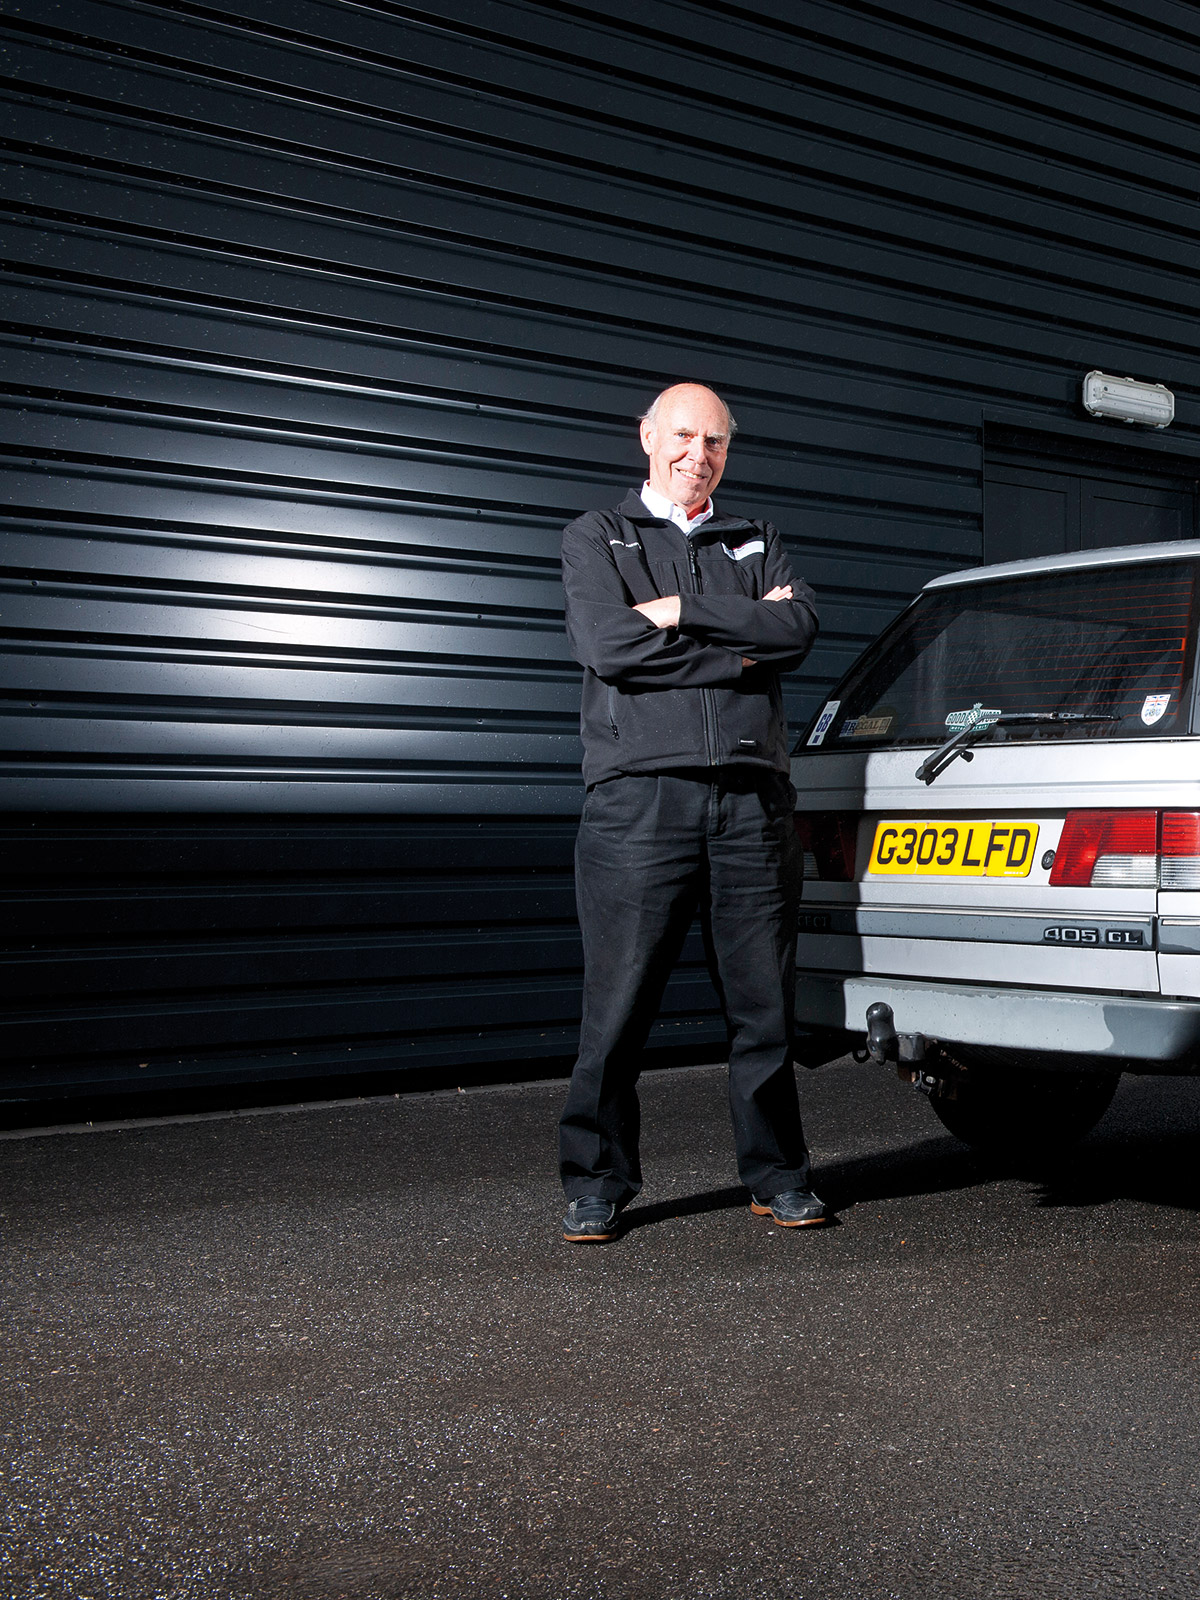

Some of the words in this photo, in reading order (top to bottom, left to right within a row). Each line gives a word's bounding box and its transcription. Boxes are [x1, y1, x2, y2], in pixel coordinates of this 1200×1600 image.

[816, 713, 833, 732] GB
[946, 712, 966, 724] GOOD
[877, 828, 959, 866] G303
[962, 828, 1031, 867] LFD
[1045, 928, 1097, 943] 405
[1108, 932, 1138, 943] GL
